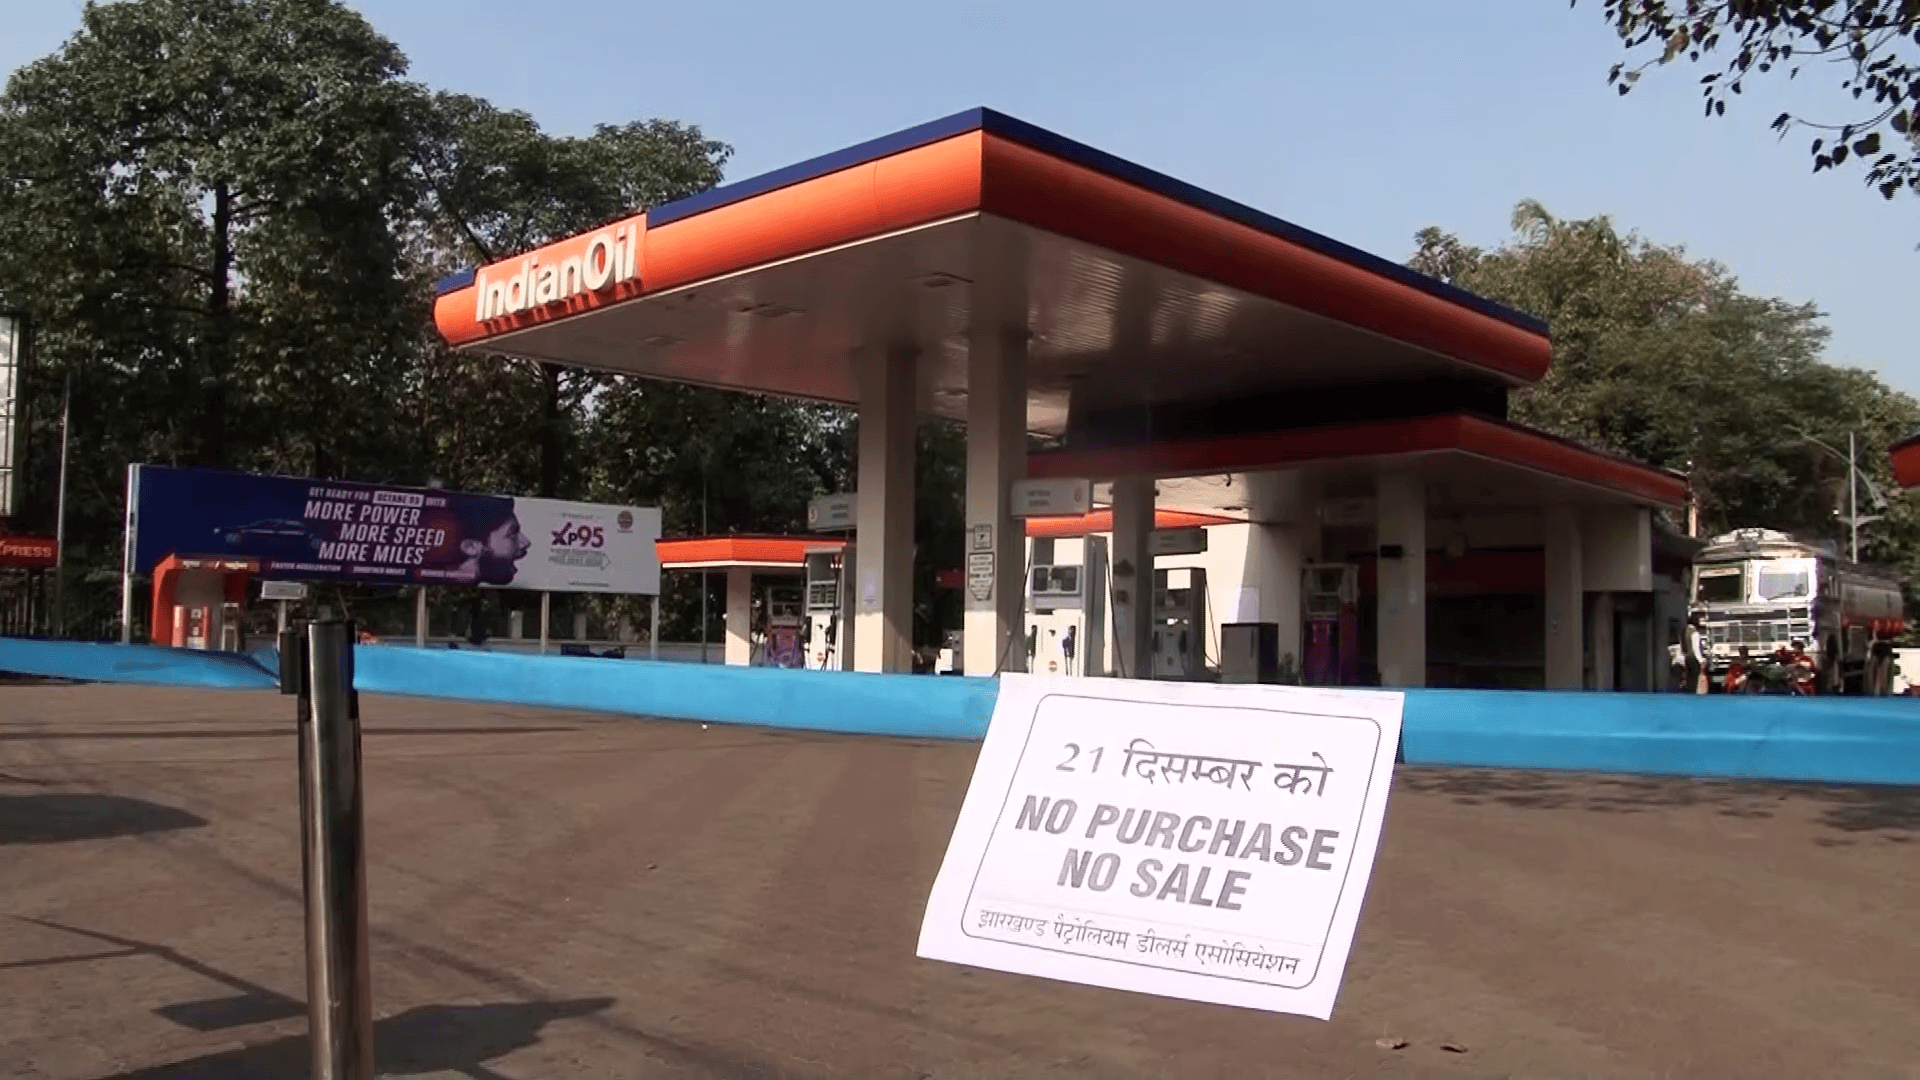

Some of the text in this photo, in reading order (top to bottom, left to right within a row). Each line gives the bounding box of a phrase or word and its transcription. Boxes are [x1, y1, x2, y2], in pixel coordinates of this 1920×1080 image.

[476, 223, 638, 321] IndianOil
[304, 500, 421, 526] MORE POWER
[339, 523, 445, 547] MORE SPEED
[318, 541, 369, 562] MORE
[1055, 738, 1334, 797] 21 दिसम्बर को
[1015, 795, 1340, 871] NO PURCHASE
[1057, 848, 1252, 911] NO SALE
[978, 909, 1049, 936] झारखण्ड
[1136, 928, 1192, 958] डीलर्स
[1195, 939, 1301, 974] एसोसियेशन
